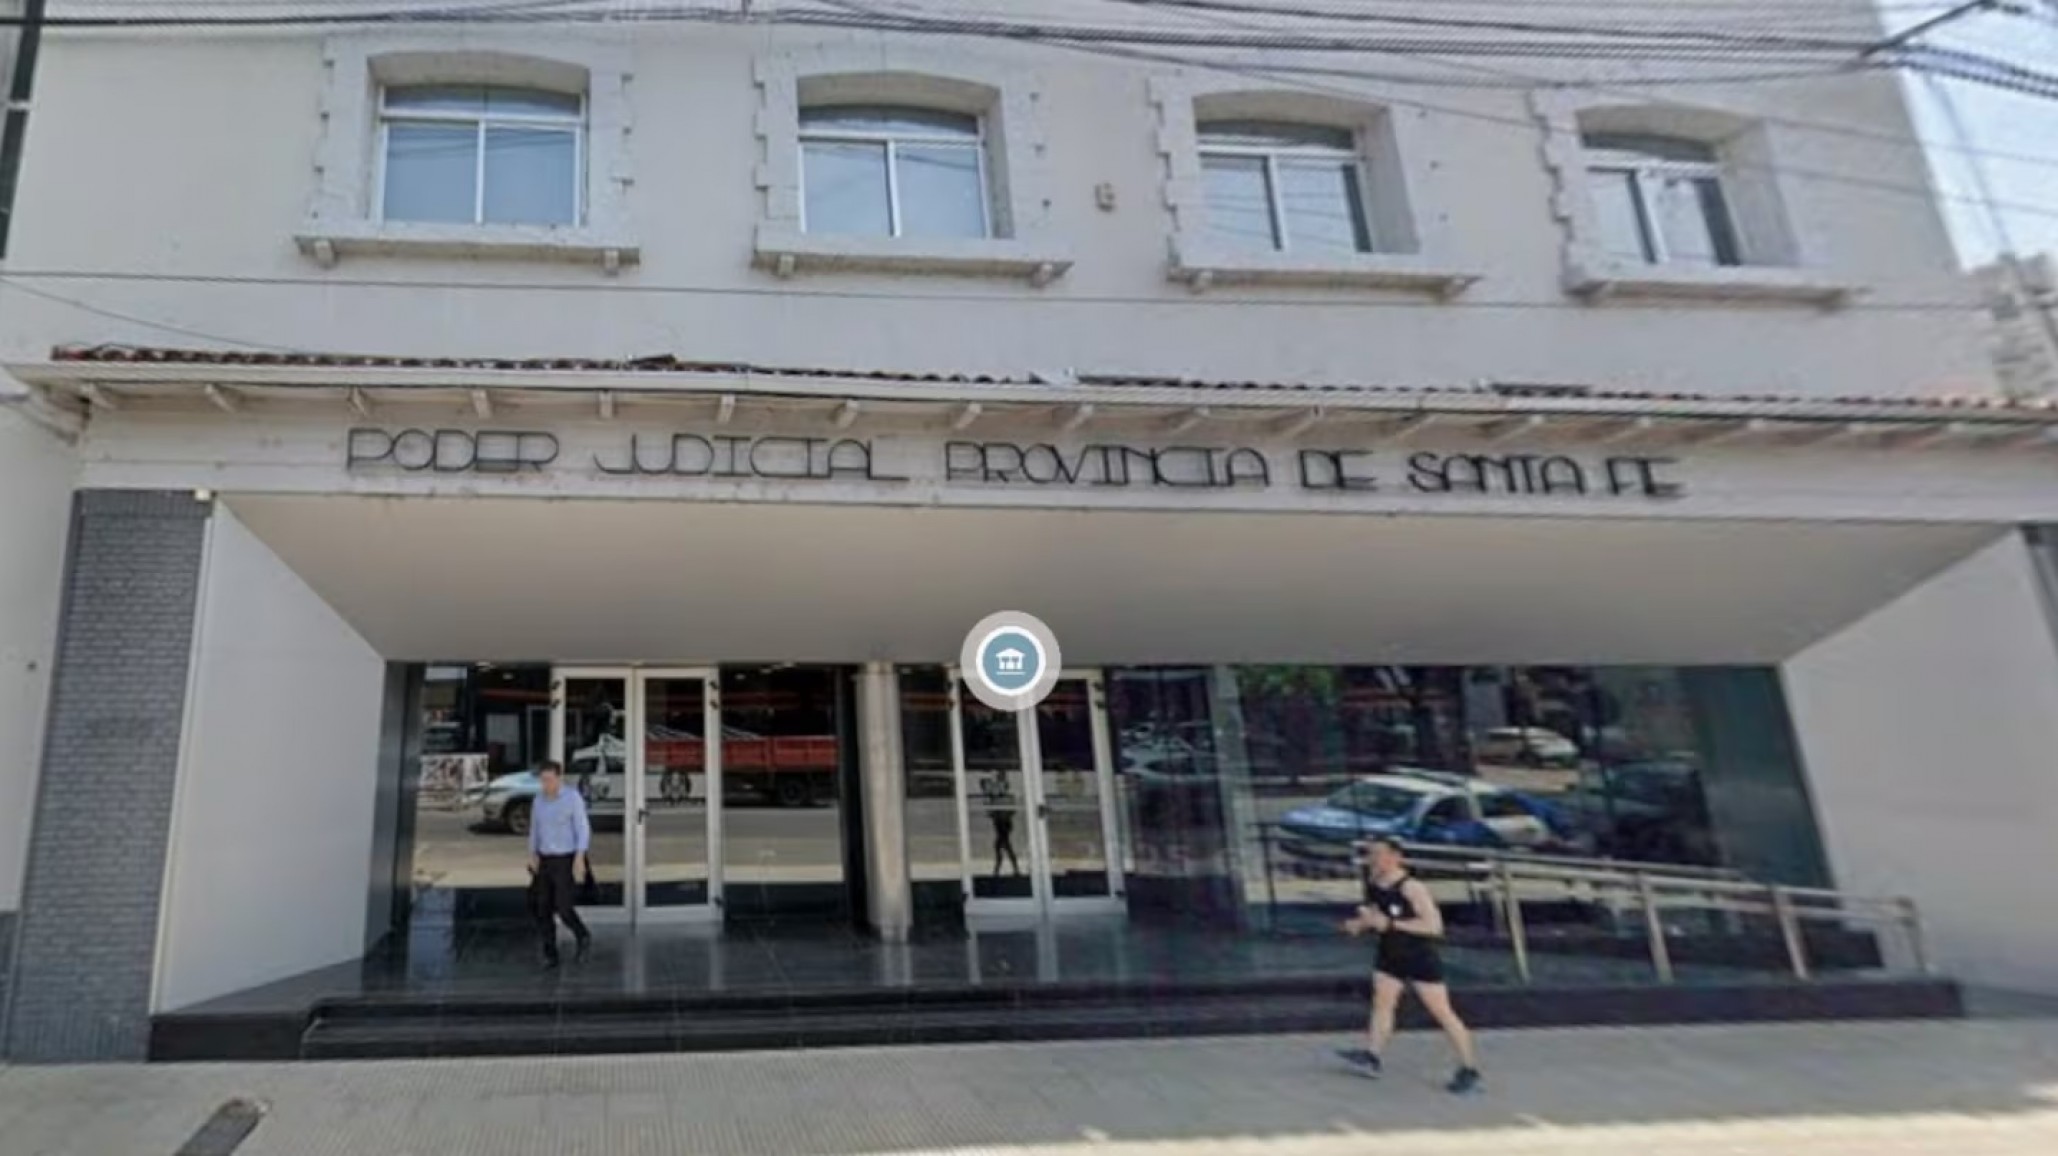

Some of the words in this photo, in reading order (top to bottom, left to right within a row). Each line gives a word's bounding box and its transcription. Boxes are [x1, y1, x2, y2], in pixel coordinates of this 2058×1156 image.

[347, 428, 559, 472] PODER
[593, 432, 911, 481] JUDICIAL
[944, 440, 1270, 488] PROVINCIA
[1299, 448, 1377, 492] DE
[1406, 450, 1585, 496] SANTA
[1606, 456, 1684, 498] FE
